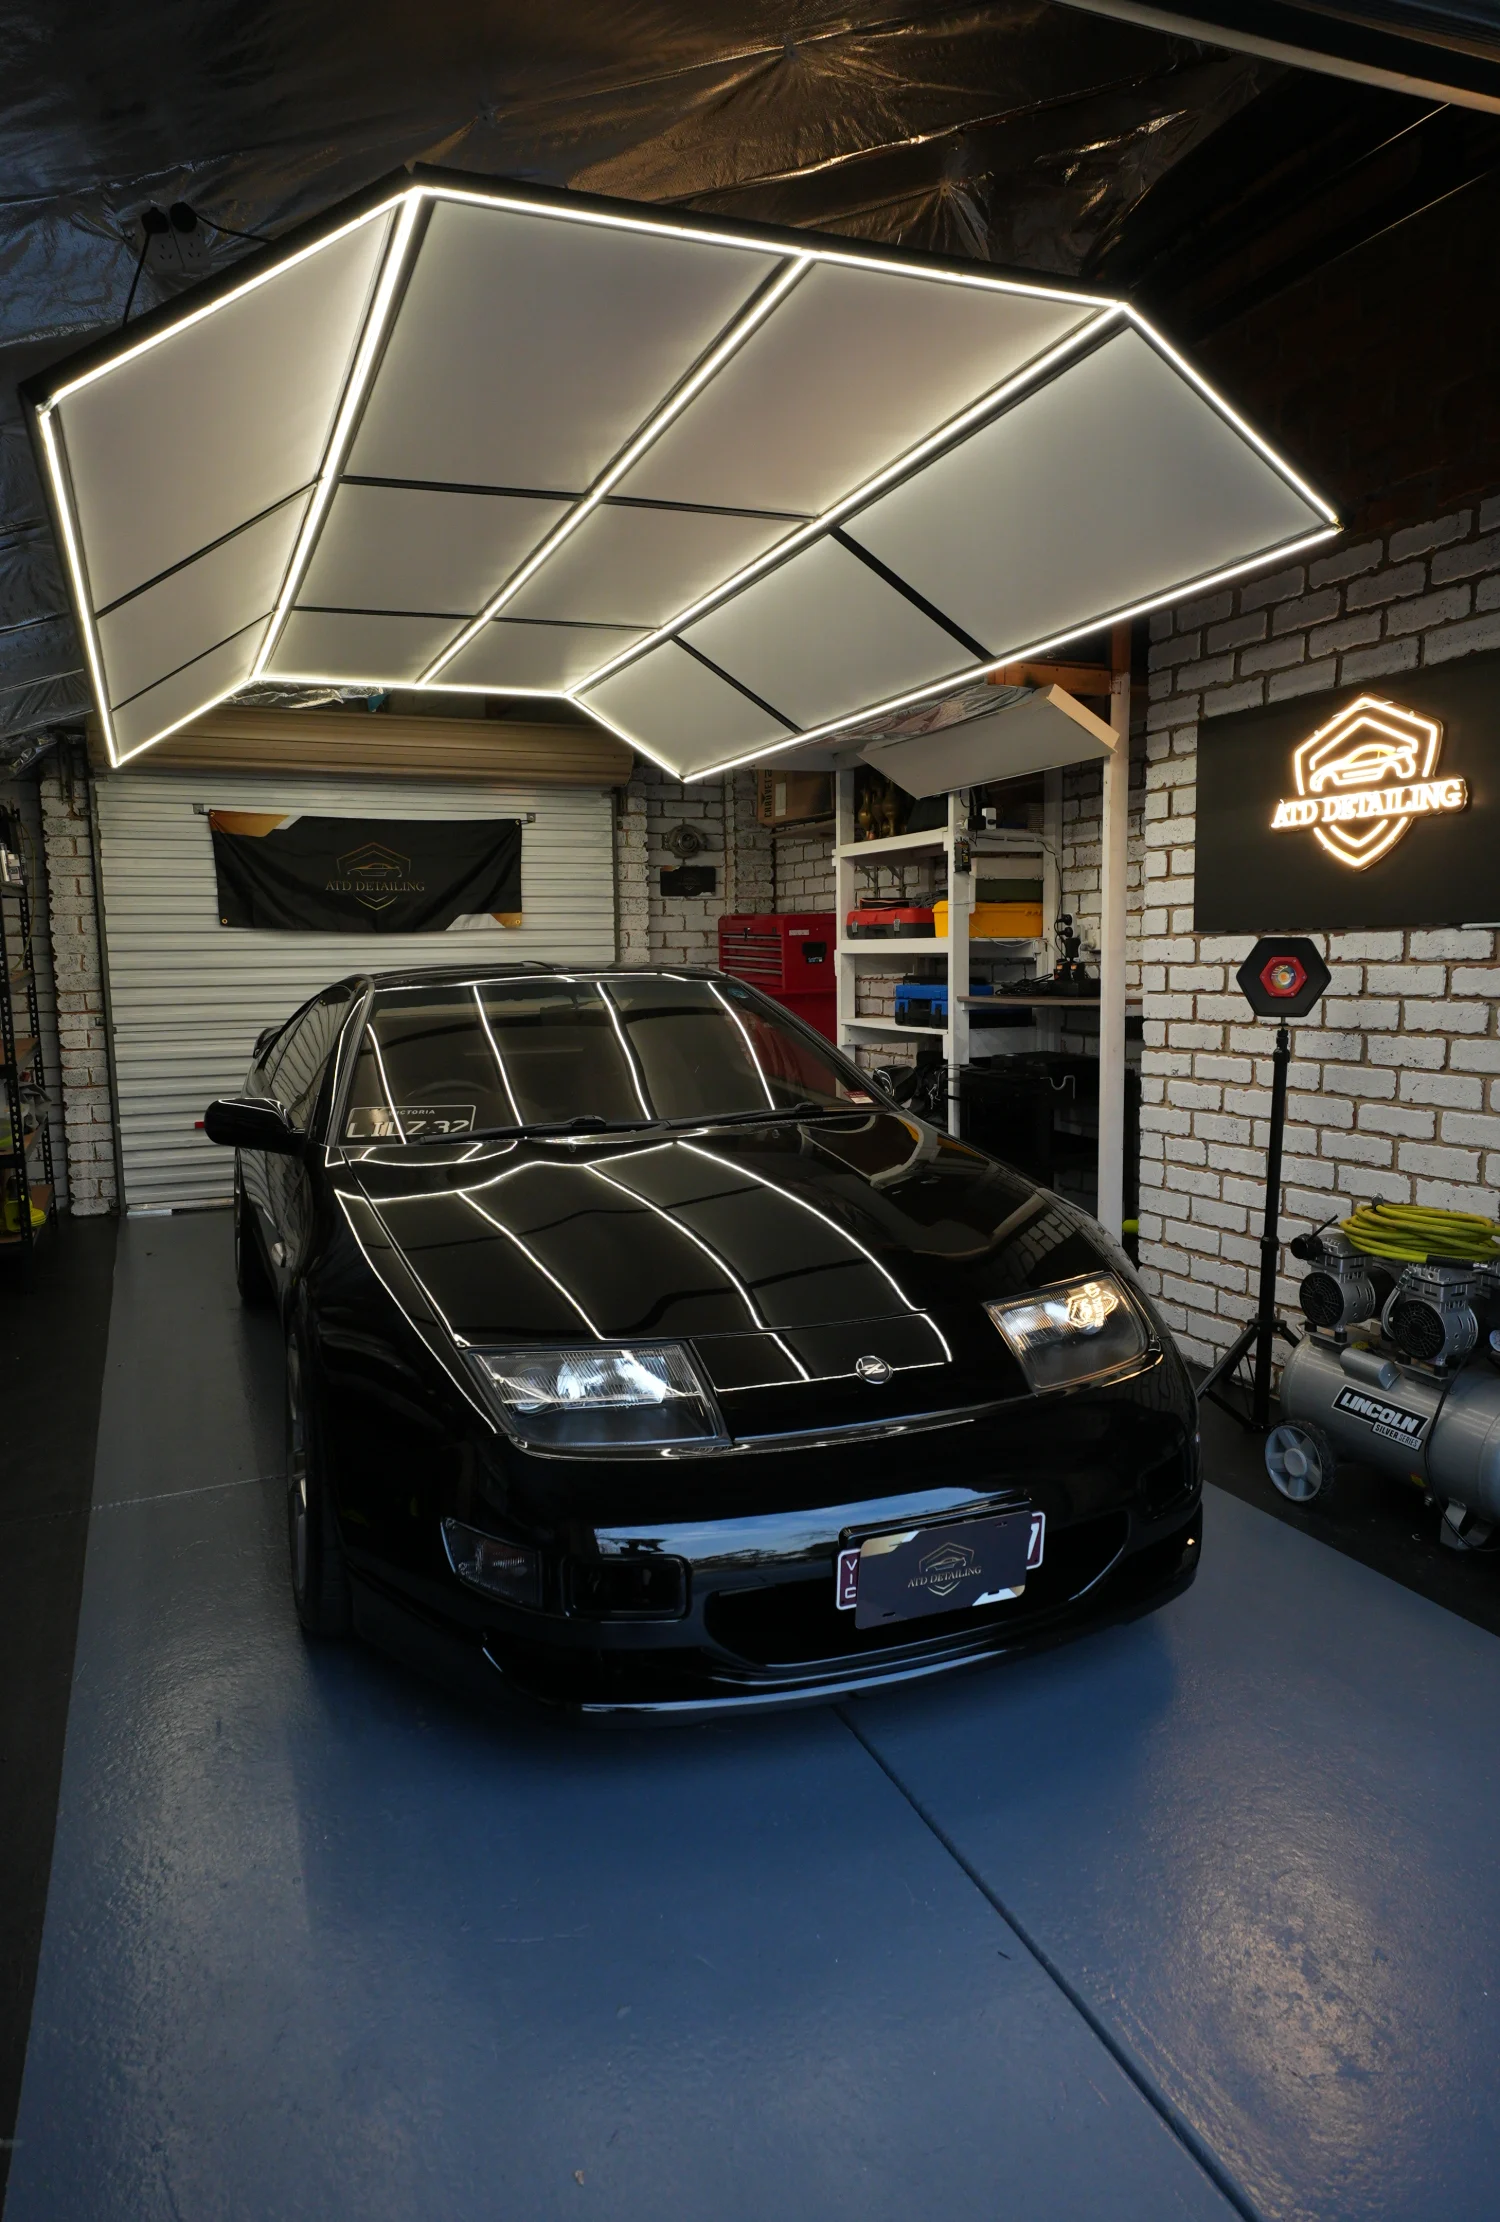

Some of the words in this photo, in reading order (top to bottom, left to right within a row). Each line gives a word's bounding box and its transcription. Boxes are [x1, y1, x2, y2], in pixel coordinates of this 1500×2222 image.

[1271, 800, 1319, 828] ATD
[1322, 778, 1463, 822] DETAILING
[325, 881, 352, 891] ATD
[355, 881, 425, 891] DETAILING
[1340, 1392, 1419, 1433] LINCOLN
[1375, 1424, 1399, 1439] SILVER
[1399, 1433, 1419, 1447] SERIES
[907, 1577, 928, 1588] ATD
[930, 1566, 982, 1584] DETAILING
